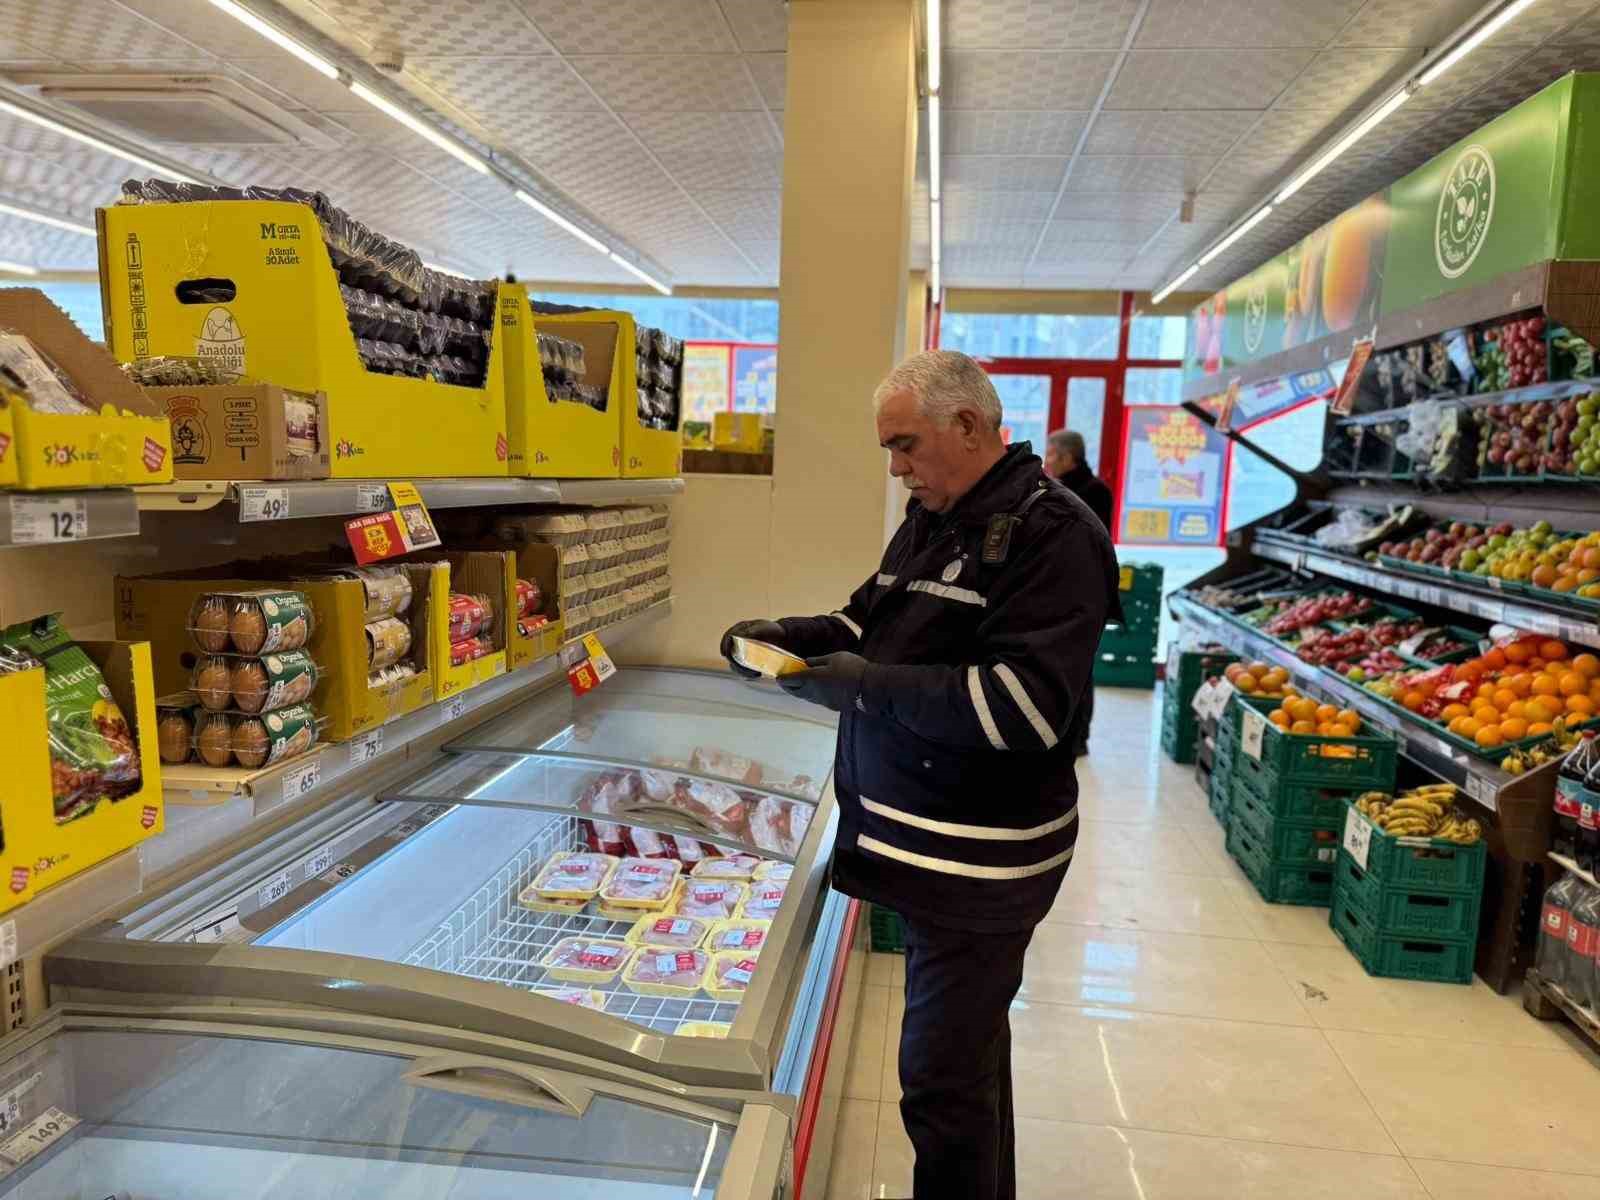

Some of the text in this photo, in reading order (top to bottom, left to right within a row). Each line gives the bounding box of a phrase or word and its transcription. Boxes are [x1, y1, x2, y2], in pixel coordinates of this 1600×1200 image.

[198, 343, 246, 355] Anadolu
[262, 499, 281, 518] 49
[51, 512, 74, 538] 12
[364, 740, 377, 757] 75
[301, 772, 314, 793] 65
[28, 1121, 60, 1143] 149
